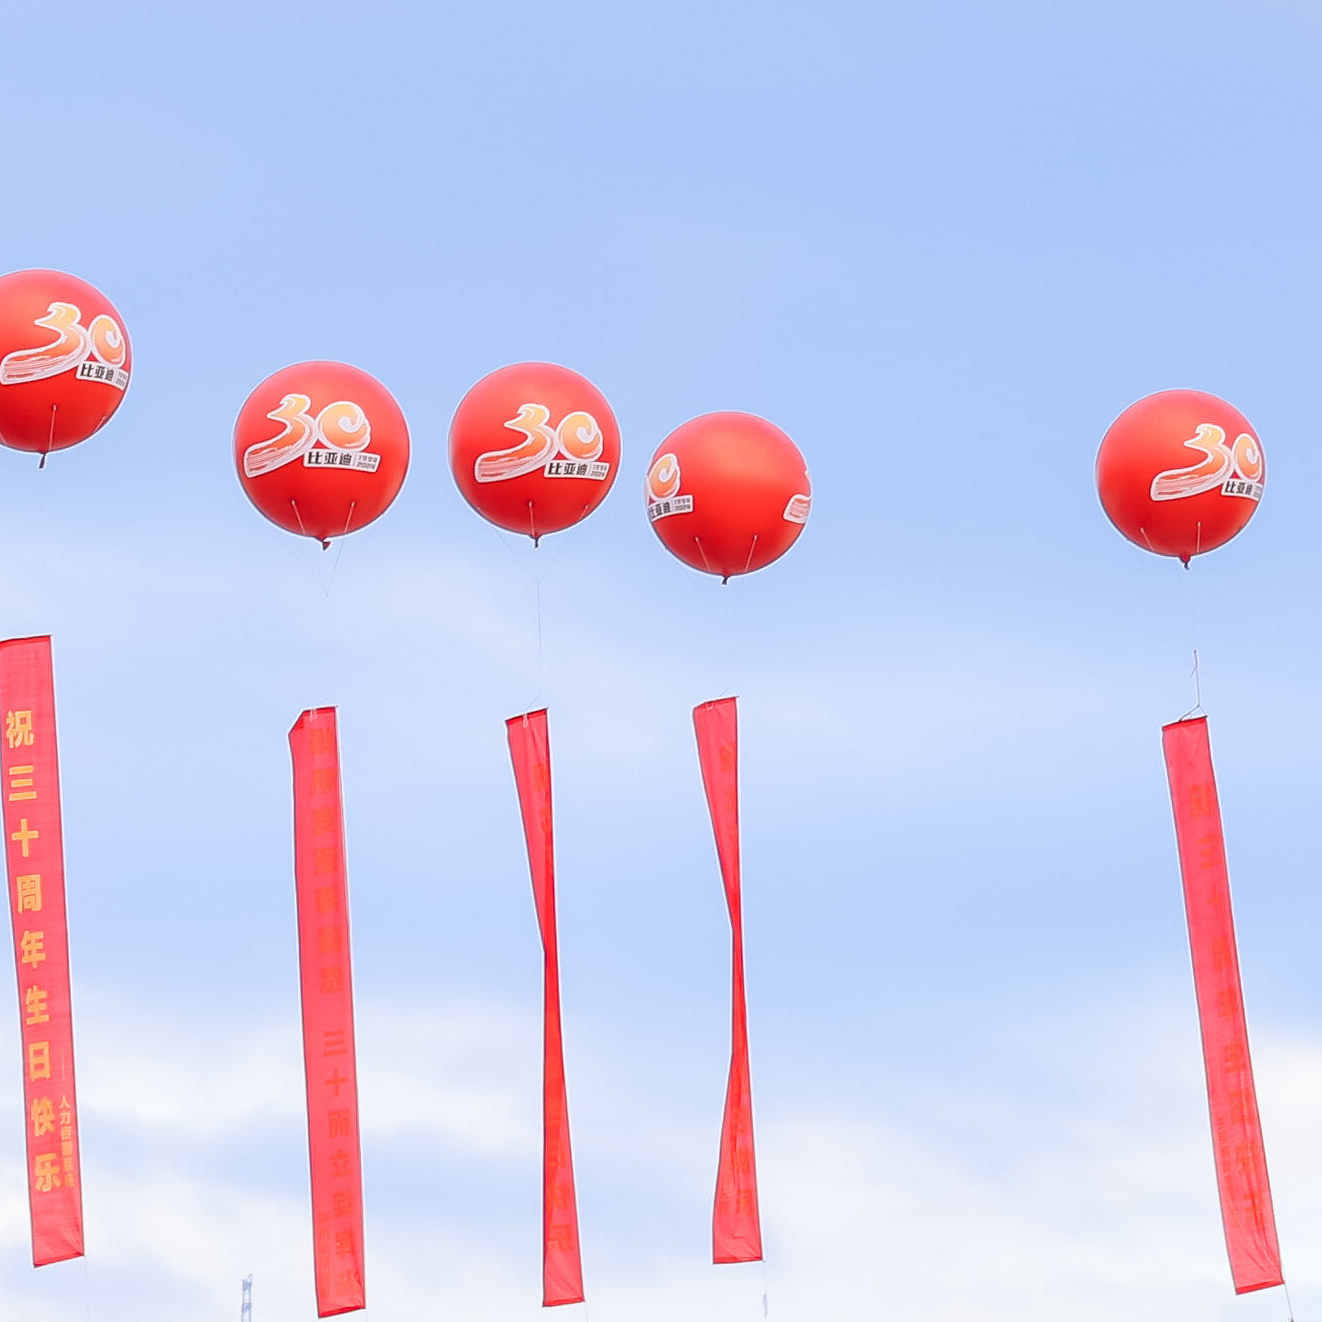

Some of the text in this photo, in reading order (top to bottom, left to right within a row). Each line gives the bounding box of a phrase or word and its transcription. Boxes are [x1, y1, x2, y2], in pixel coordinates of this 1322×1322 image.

[81, 362, 114, 381] 比亚迪
[308, 451, 352, 466] 比亚迪
[548, 462, 587, 476] 比亚迪
[6, 710, 61, 1192] 祝三十周年生日快乐
